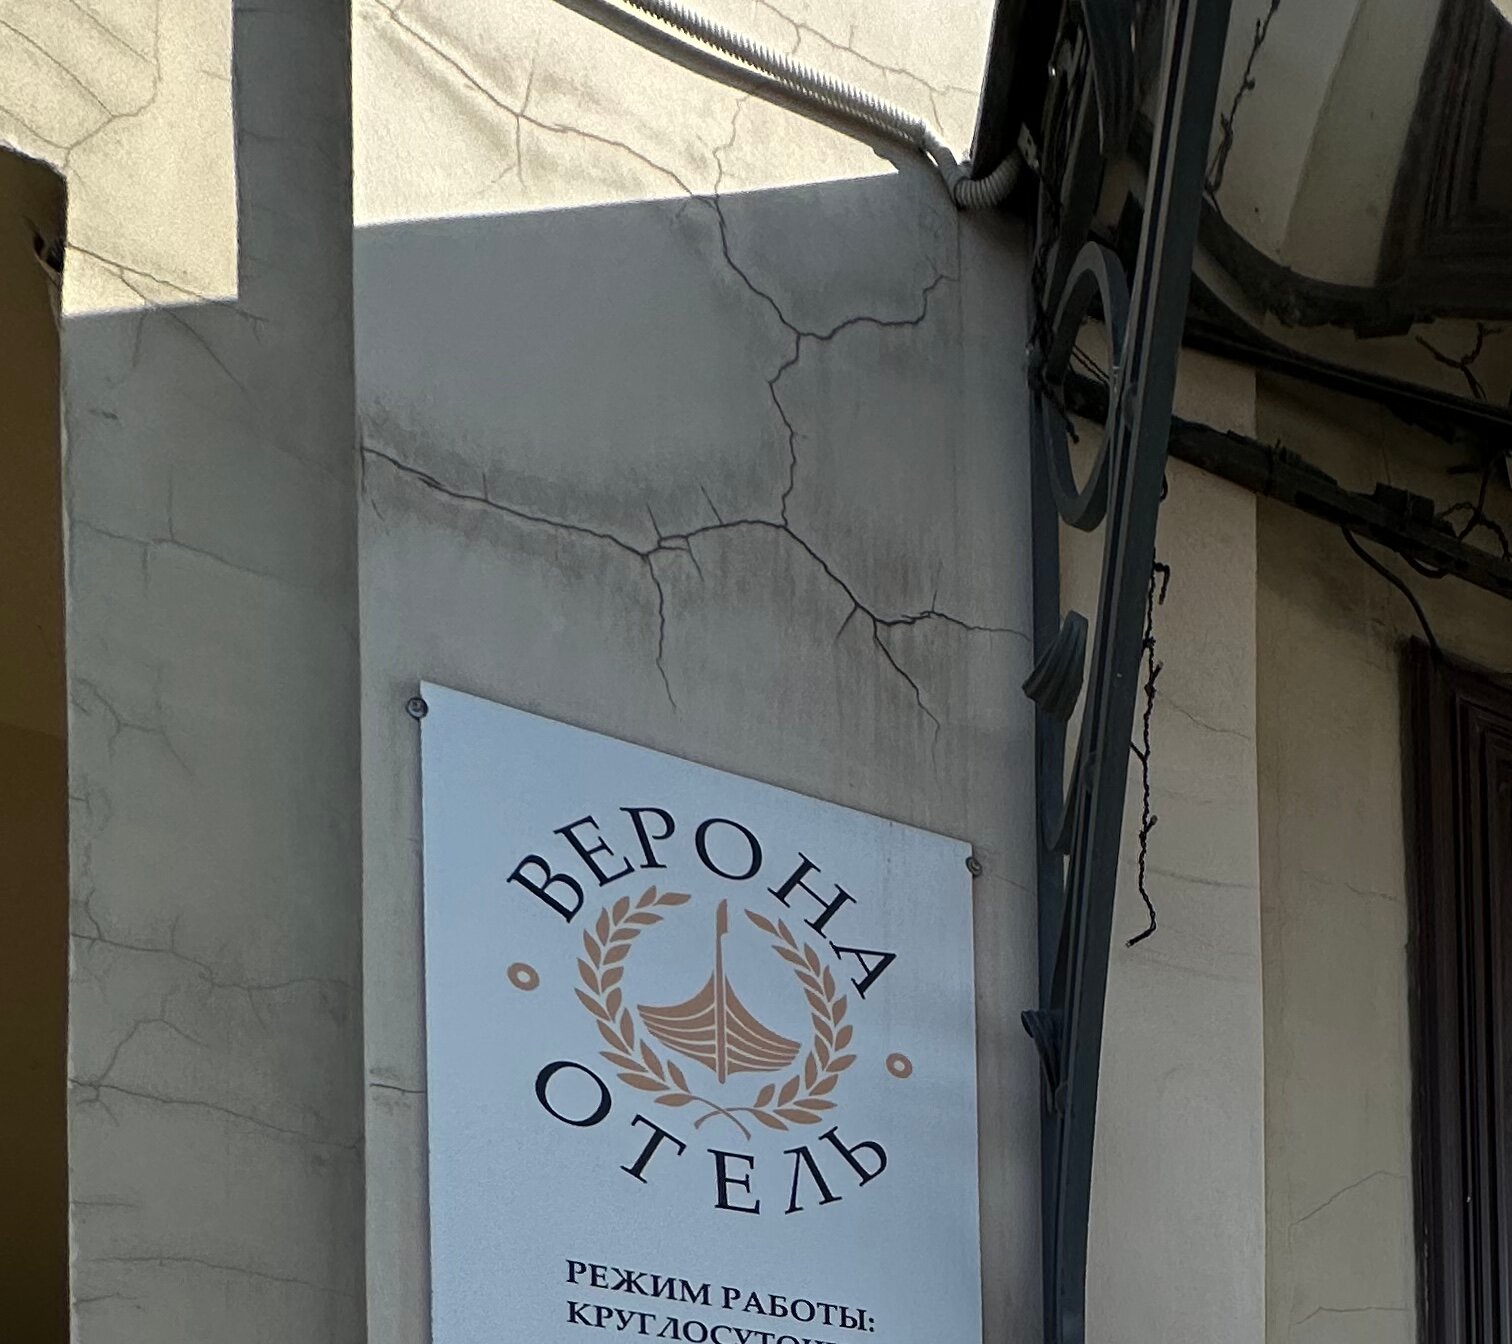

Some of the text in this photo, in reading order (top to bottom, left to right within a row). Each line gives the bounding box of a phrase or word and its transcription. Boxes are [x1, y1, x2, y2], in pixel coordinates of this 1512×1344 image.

[506, 806, 898, 999] ВЕРОНА
[535, 1060, 888, 1215] ОТЕЛЬ
[565, 1259, 876, 1332] РЕЖИМ РАБОТЫ:
